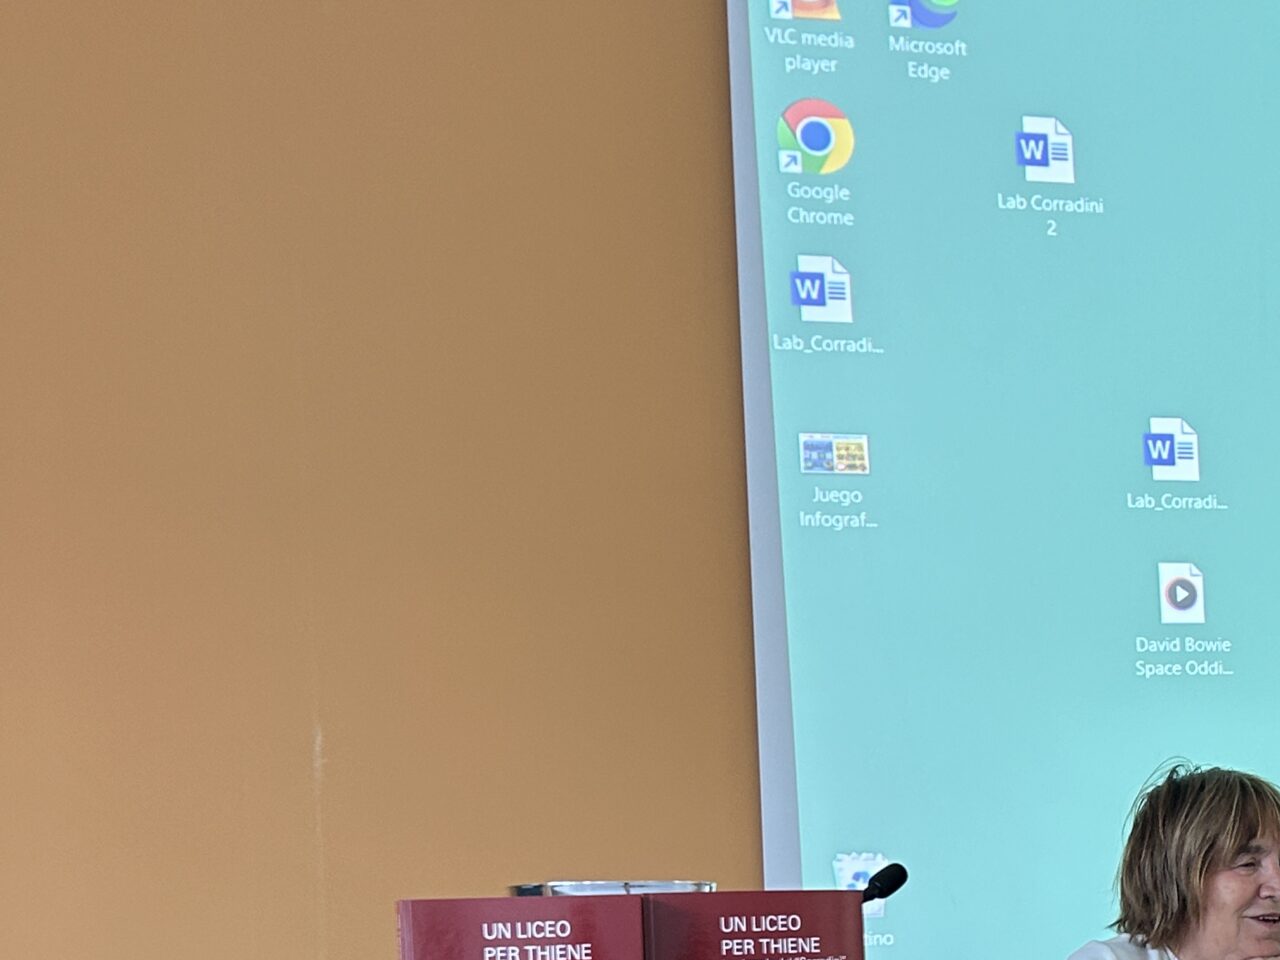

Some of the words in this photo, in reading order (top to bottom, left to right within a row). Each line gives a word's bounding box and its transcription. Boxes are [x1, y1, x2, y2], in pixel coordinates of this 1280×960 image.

[764, 27, 797, 45] VLC
[801, 31, 855, 49] media
[889, 36, 967, 57] Microsoft
[785, 56, 838, 75] player
[908, 62, 950, 83] Edge
[1020, 139, 1044, 160] W
[787, 182, 850, 202] Google
[998, 193, 1027, 211] Lab
[1030, 194, 1104, 214] Corradini
[787, 207, 855, 226] Chrome
[1047, 220, 1057, 236] 2
[795, 279, 821, 300] W
[1147, 441, 1172, 460] W
[812, 487, 863, 505] Juego
[1136, 636, 1180, 653] David
[1185, 637, 1232, 653] Bowie
[1135, 660, 1181, 678] Space
[482, 922, 511, 940] UN
[516, 920, 571, 939] LICEO
[720, 916, 746, 932] UN
[751, 914, 801, 932] LICEO
[721, 939, 754, 956] PER
[758, 937, 821, 954] THIENE
